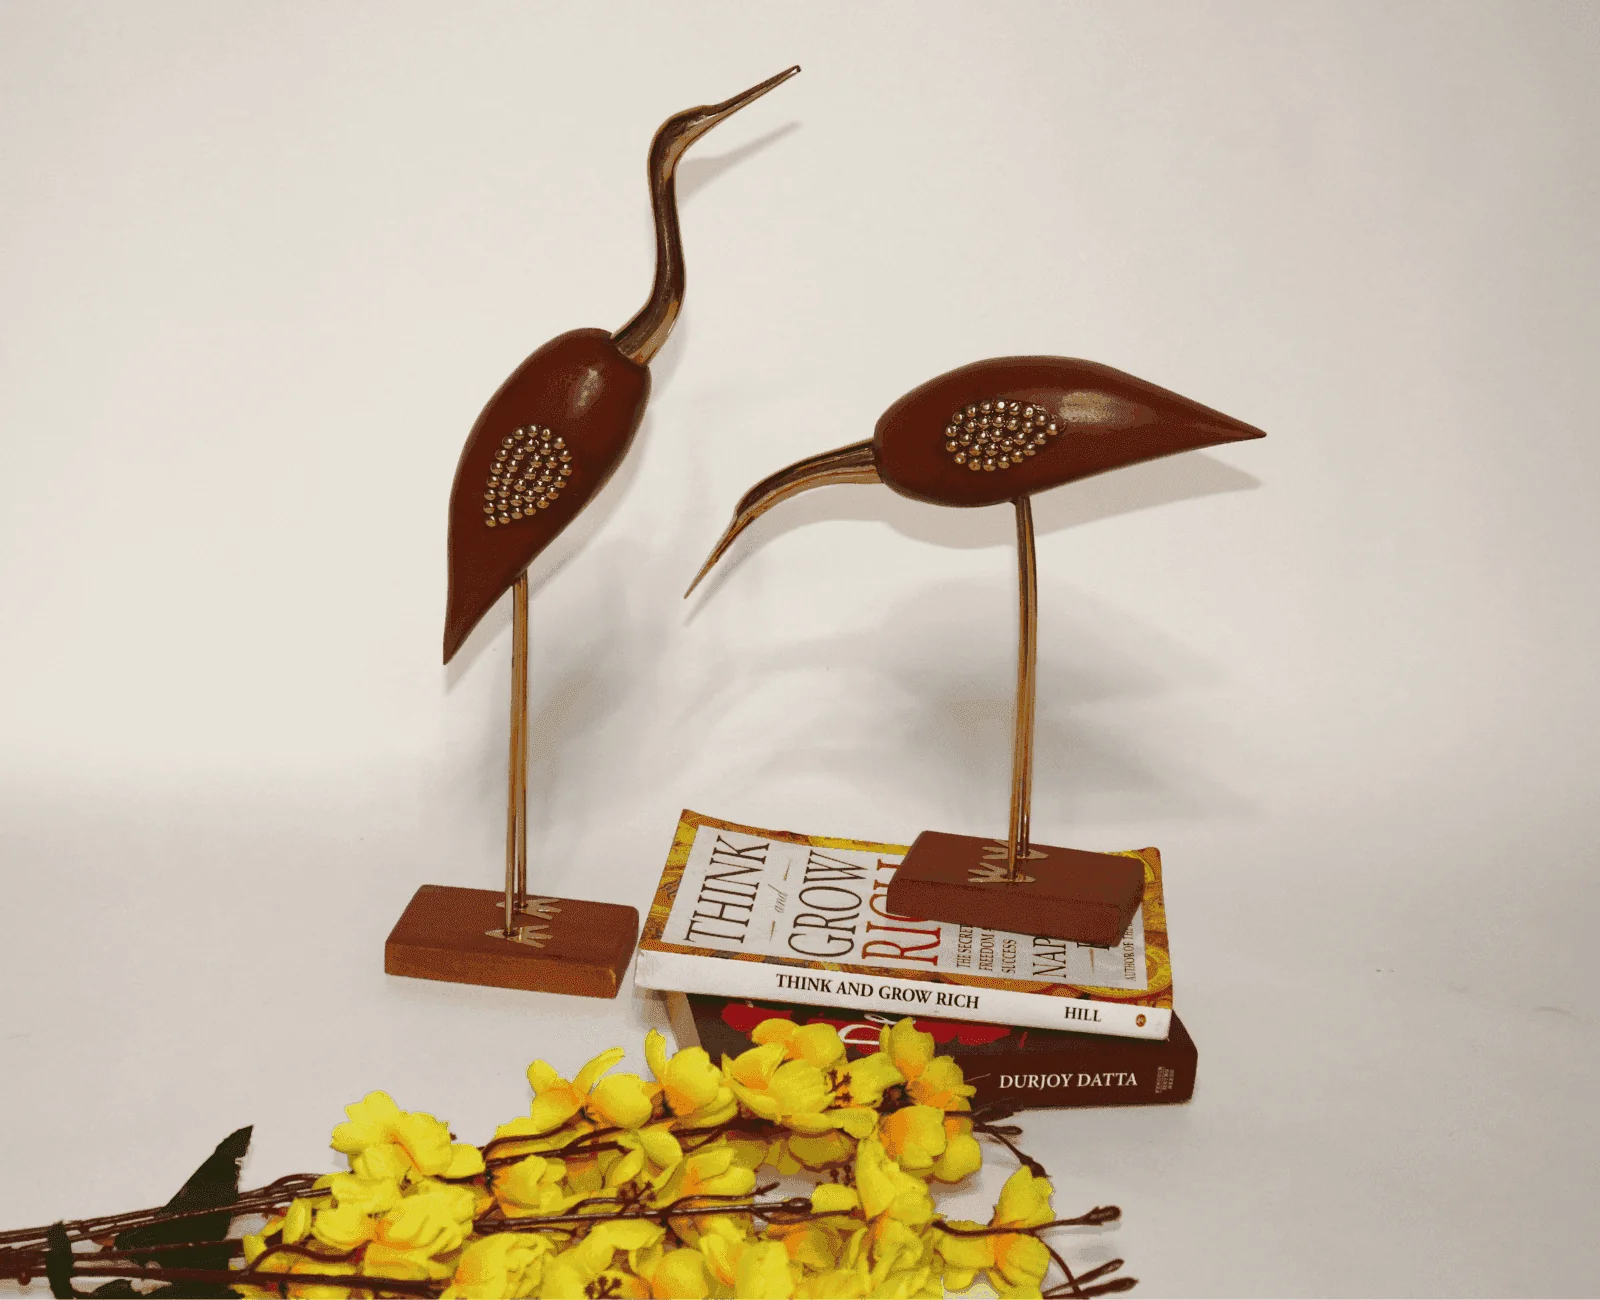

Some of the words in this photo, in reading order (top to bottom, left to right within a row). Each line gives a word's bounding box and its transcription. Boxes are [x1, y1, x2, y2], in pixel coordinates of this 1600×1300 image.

[684, 834, 770, 944] THINK
[766, 883, 788, 914] and
[788, 849, 868, 958] GROW
[978, 934, 994, 972] FREEDOM
[1001, 939, 1017, 975] SUCCESS
[1123, 941, 1134, 952] OF
[1123, 952, 1137, 982] AUTHOR
[776, 973, 832, 994] THINK
[836, 981, 874, 998] AND
[878, 986, 933, 1005] GROW
[936, 992, 980, 1010] RICH
[1064, 1006, 1102, 1023] HILL
[999, 1073, 1074, 1091] DURJOY
[1077, 1072, 1138, 1088] DATTA
